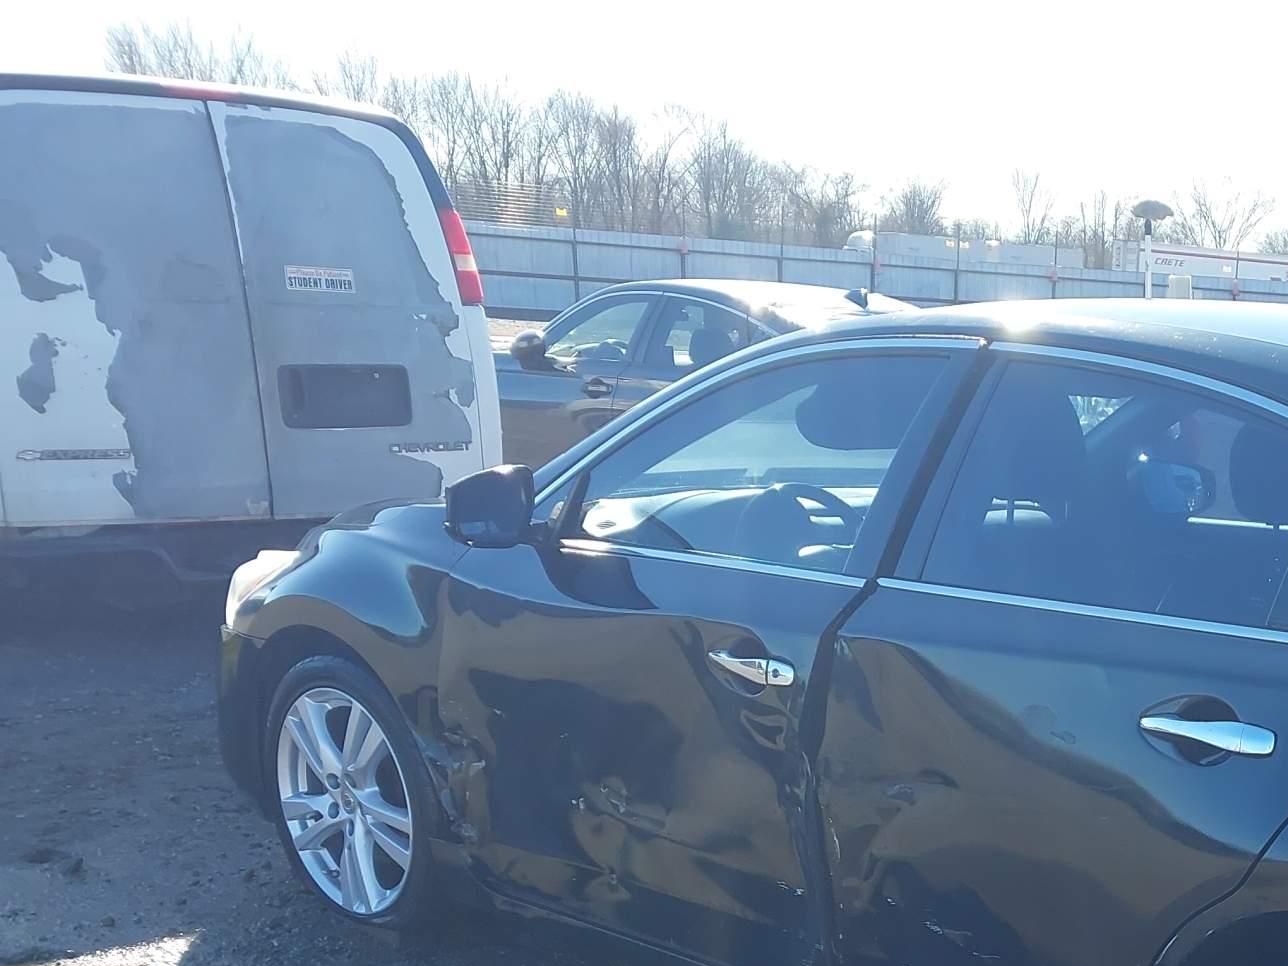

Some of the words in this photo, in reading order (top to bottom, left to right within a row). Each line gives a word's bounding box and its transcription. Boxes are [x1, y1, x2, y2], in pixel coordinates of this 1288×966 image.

[1154, 257, 1186, 267] CRETE
[288, 276, 322, 288] STUDENT
[325, 278, 353, 290] DRIVER
[389, 440, 472, 454] CHEVROLET
[40, 449, 130, 460] EXPRESS
